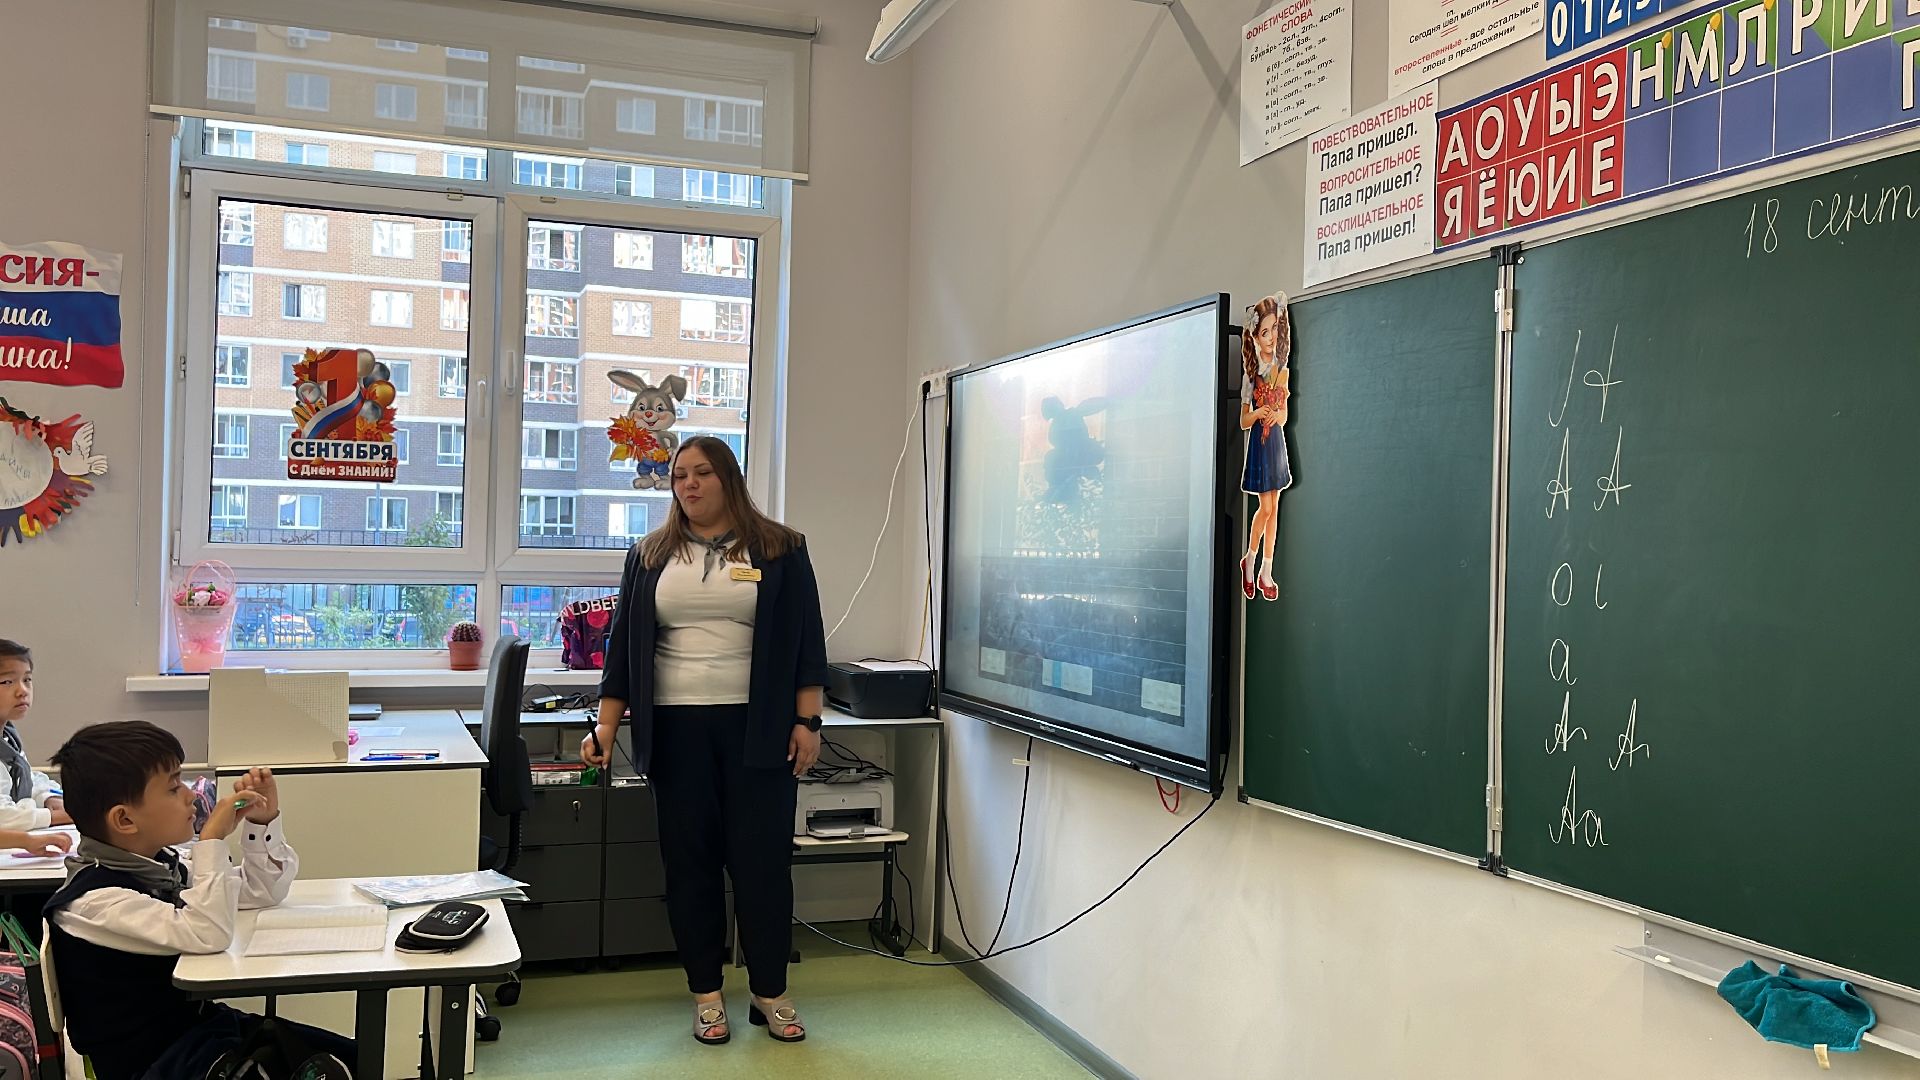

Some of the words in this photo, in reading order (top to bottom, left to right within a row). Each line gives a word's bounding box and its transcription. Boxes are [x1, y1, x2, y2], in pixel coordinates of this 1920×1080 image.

[1281, 8, 1314, 33] СЛОВА
[1394, 38, 1463, 76] второстепенные
[1469, 27, 1485, 40] все
[1487, 2, 1540, 31] остальные
[1409, 25, 1441, 44] Сегодня
[1442, 15, 1459, 28] шел
[1551, 1, 1568, 47] 0
[1581, 0, 1593, 34] 1
[1422, 58, 1446, 74] слова
[1448, 53, 1454, 62] в
[1455, 25, 1516, 59] предложении
[1440, 120, 1469, 174] А
[1475, 105, 1506, 161] О
[1512, 88, 1540, 148] У
[1548, 73, 1582, 137] Ы
[1592, 61, 1619, 122] Э
[1631, 40, 1665, 109] Н
[1674, 22, 1720, 96] М
[1728, 2, 1767, 76] Л
[1312, 92, 1434, 155] ПОВЕСТВОВАТЕЛЬНОЕ
[1320, 146, 1354, 172] Папа
[1357, 122, 1418, 158] пришел.
[1319, 190, 1352, 216] Папа
[1356, 162, 1423, 205] пришел?
[1320, 145, 1421, 195] ВОПРОСИТЕЛЬНОЕ
[1441, 185, 1464, 238] Я
[1477, 167, 1496, 229] Ё
[1506, 162, 1541, 222] Ю
[1547, 147, 1577, 211] И
[1591, 135, 1616, 198] Е
[1317, 193, 1424, 240] ВОСКЛИЦАТЕЛЬНОЕ
[1318, 235, 1351, 261] Папа
[1354, 213, 1416, 252] пришел!
[1744, 198, 1780, 259] 18
[289, 465, 298, 474] С
[300, 465, 336, 476] Днём
[338, 464, 394, 477] ЗНАНИЙ!
[290, 441, 393, 460] СЕНТЯБРЯ
[1548, 765, 1608, 848] Аа
